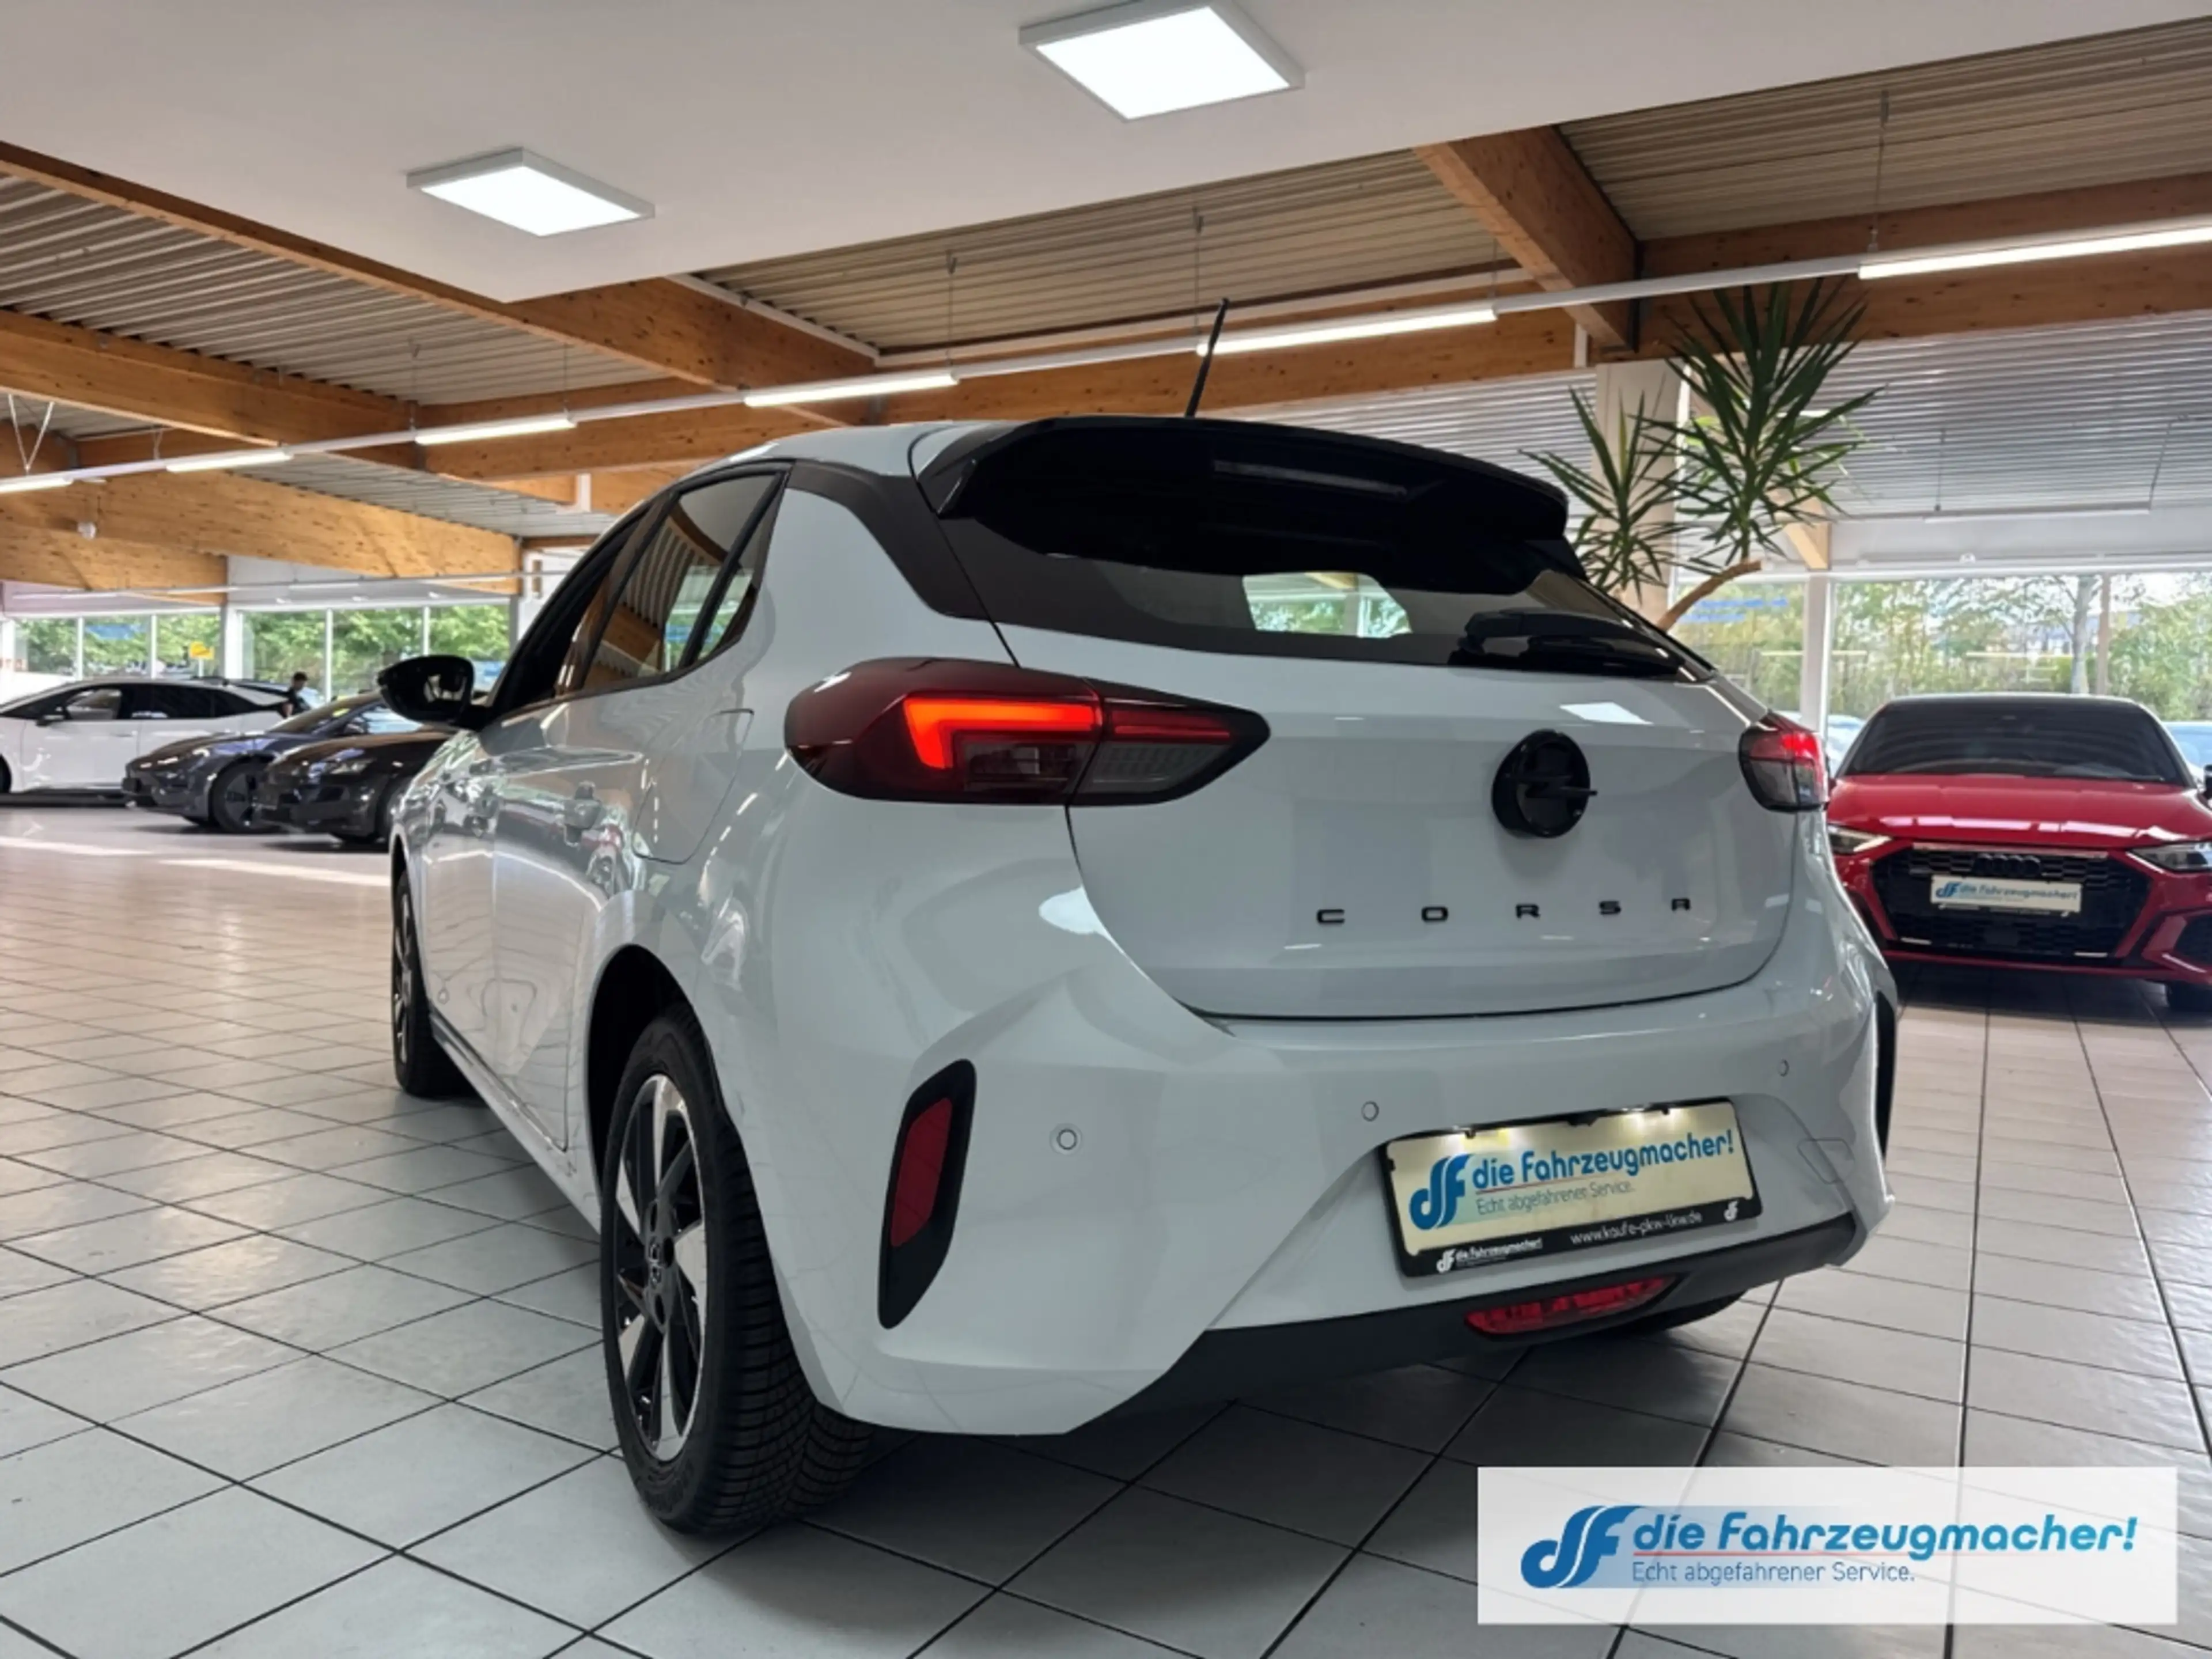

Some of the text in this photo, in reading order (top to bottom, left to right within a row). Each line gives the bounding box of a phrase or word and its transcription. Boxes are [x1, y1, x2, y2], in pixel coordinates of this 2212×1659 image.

[1316, 897, 1691, 924] CORSA
[1472, 1130, 1734, 1190] die Fahrzeugmacher!
[1475, 1195, 1504, 1215] Echt
